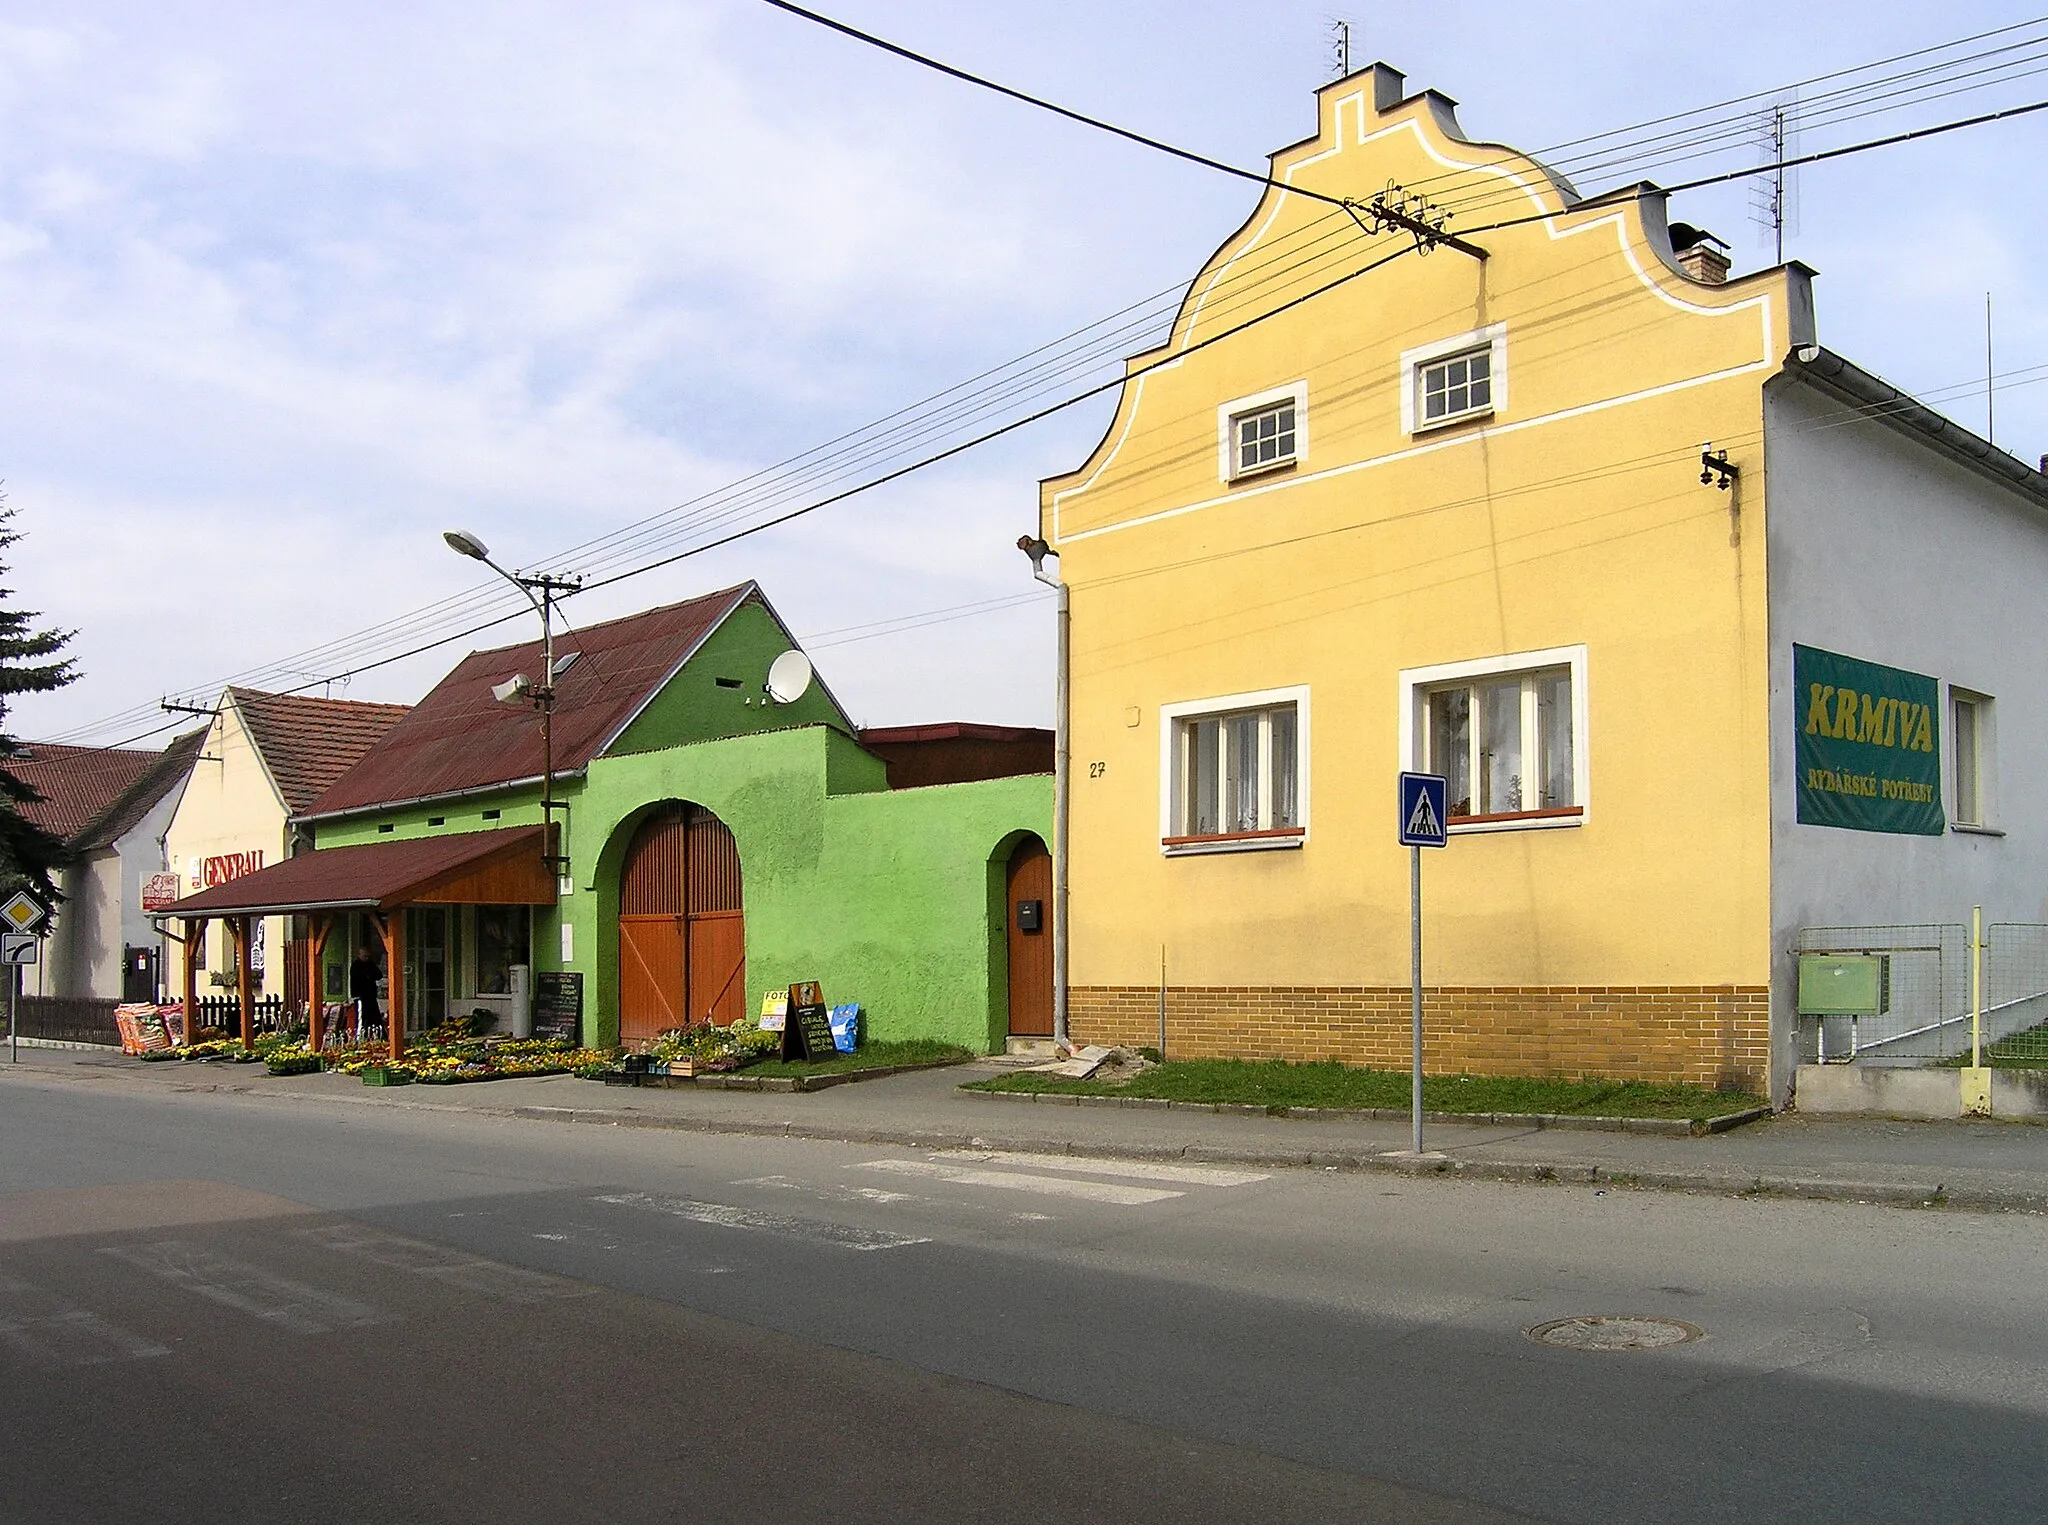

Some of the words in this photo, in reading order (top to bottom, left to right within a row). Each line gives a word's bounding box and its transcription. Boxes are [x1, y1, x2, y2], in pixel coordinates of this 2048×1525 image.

[1805, 683, 1933, 753] KRMIVA
[1090, 761, 1106, 779] 27
[1808, 766, 1877, 798] RYBÁŘSKÉ
[1881, 776, 1933, 803] POTŘEBY
